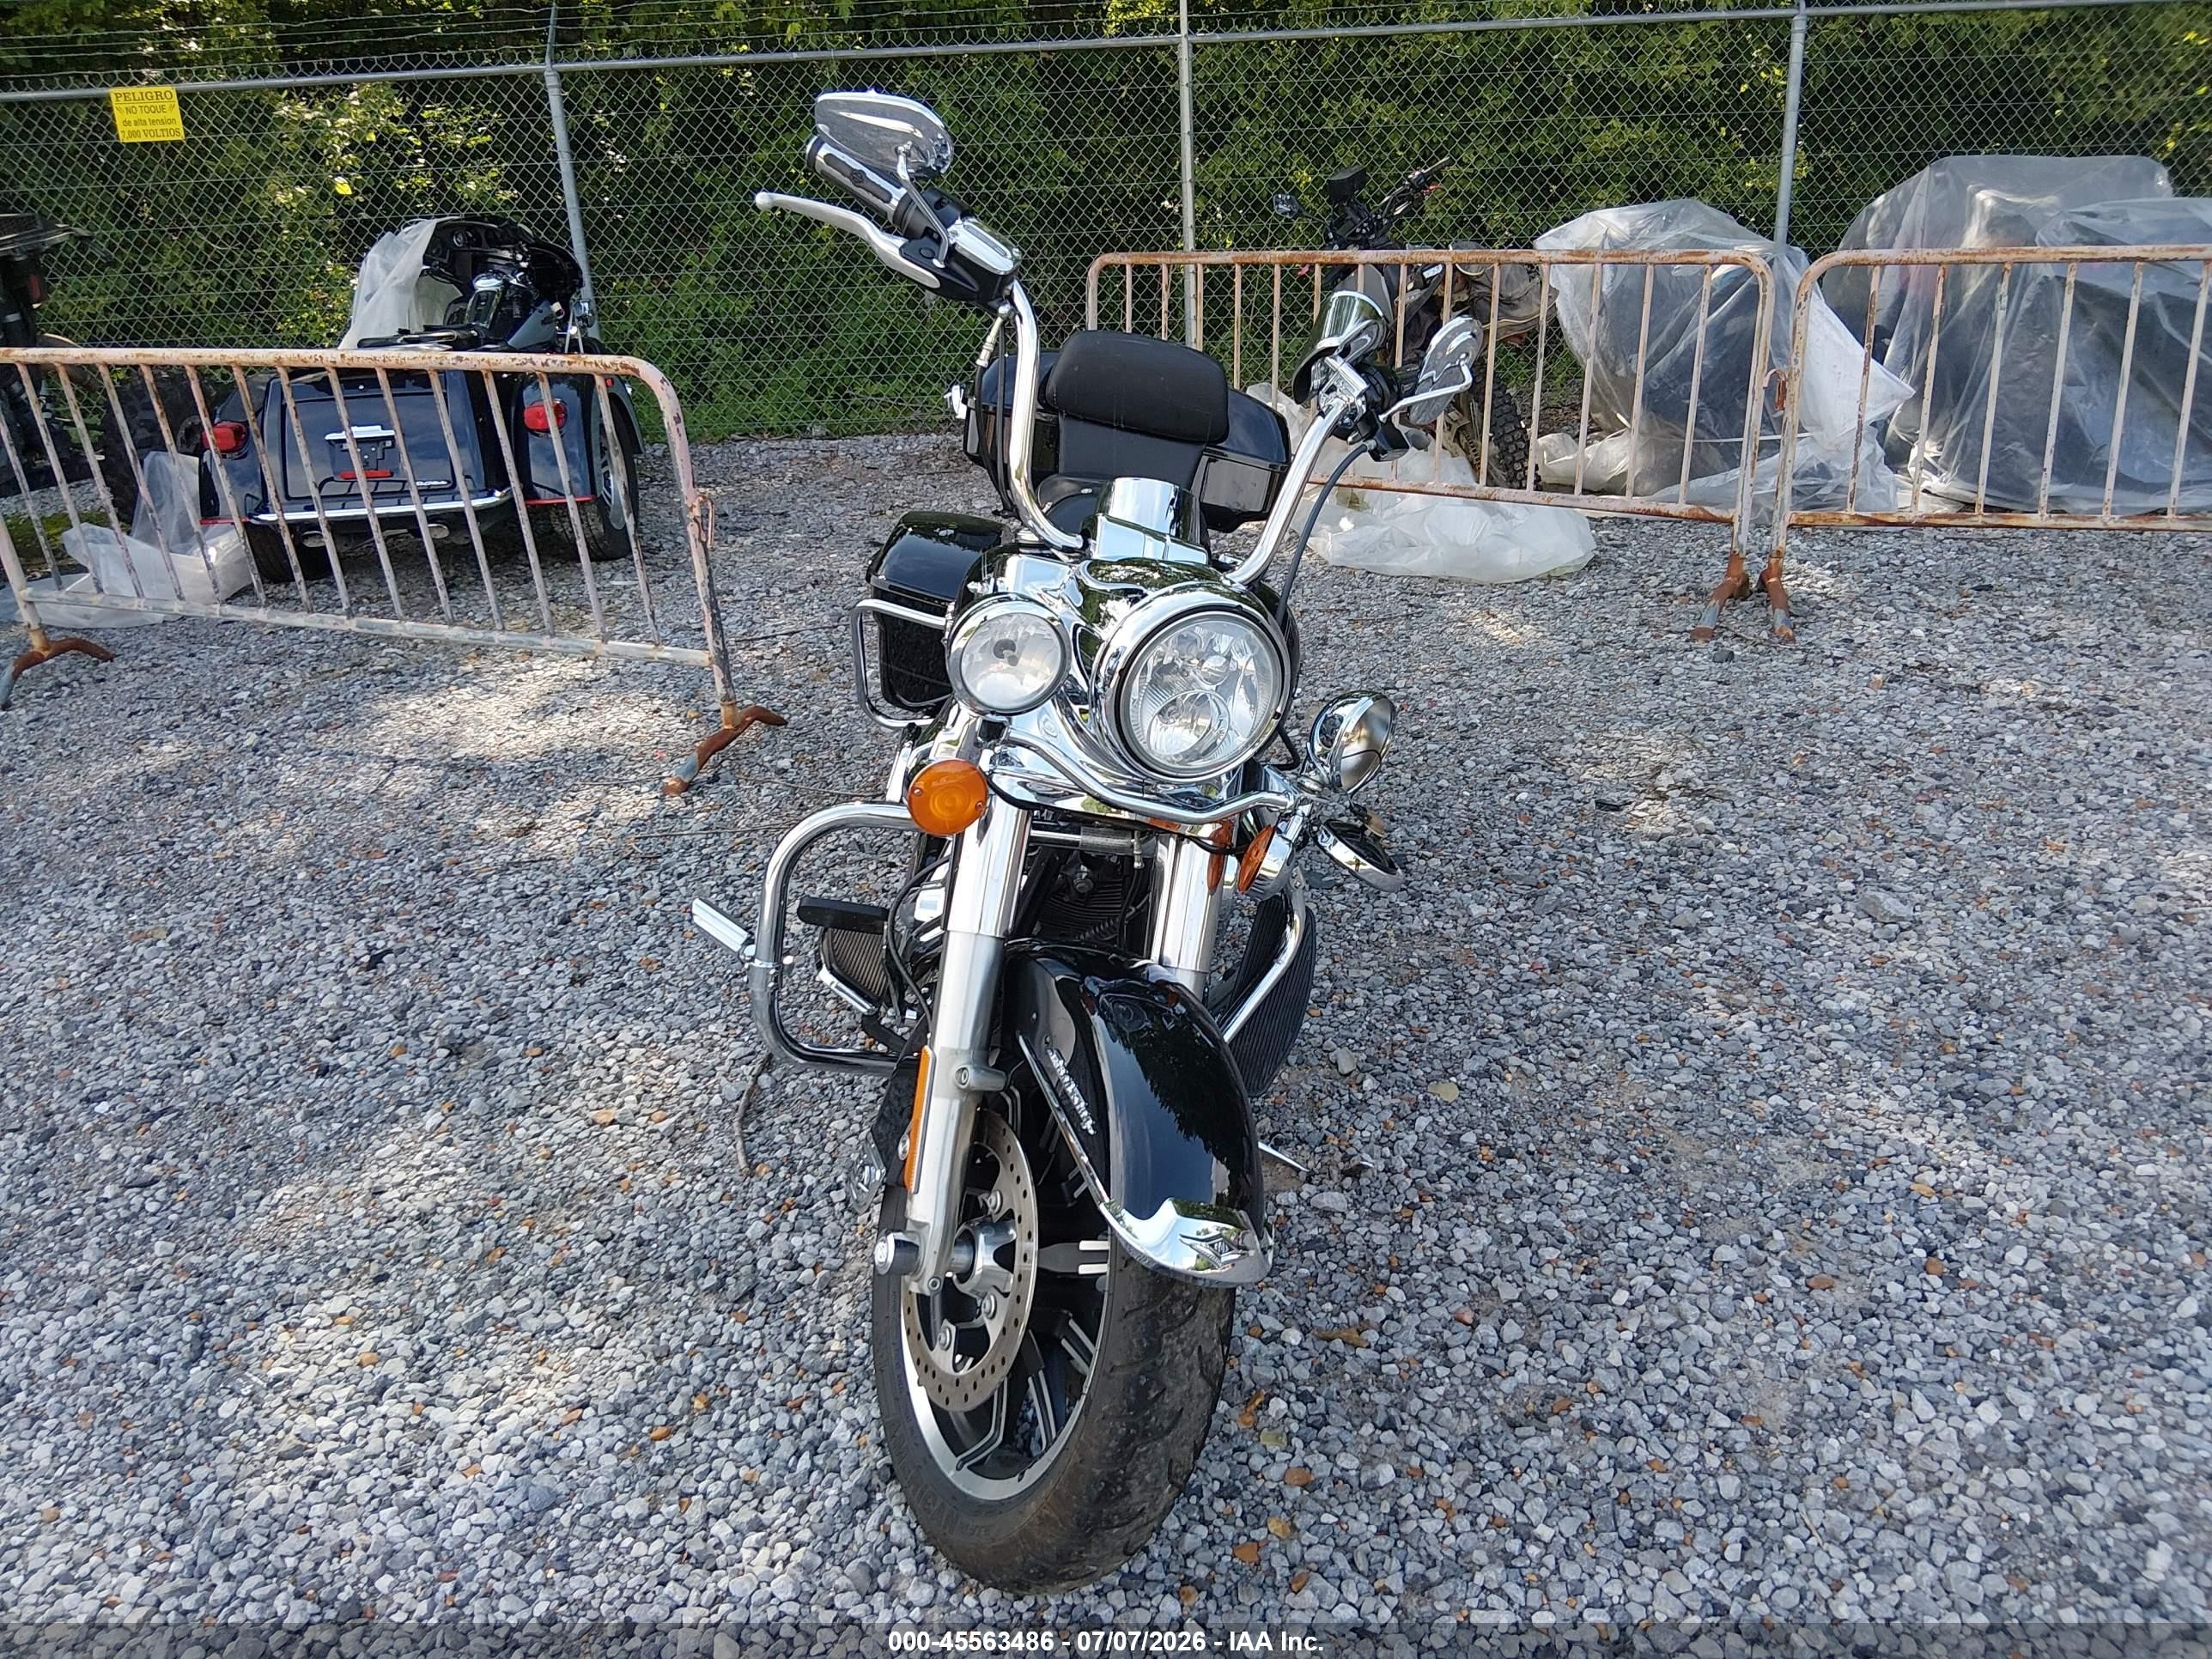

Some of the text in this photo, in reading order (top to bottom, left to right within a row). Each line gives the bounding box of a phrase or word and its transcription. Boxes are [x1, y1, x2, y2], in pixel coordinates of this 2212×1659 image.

[114, 90, 173, 102] PELIGRO
[125, 105, 167, 115] NO TOQUE
[149, 117, 177, 125] tension
[143, 128, 181, 138] VOLTIOS
